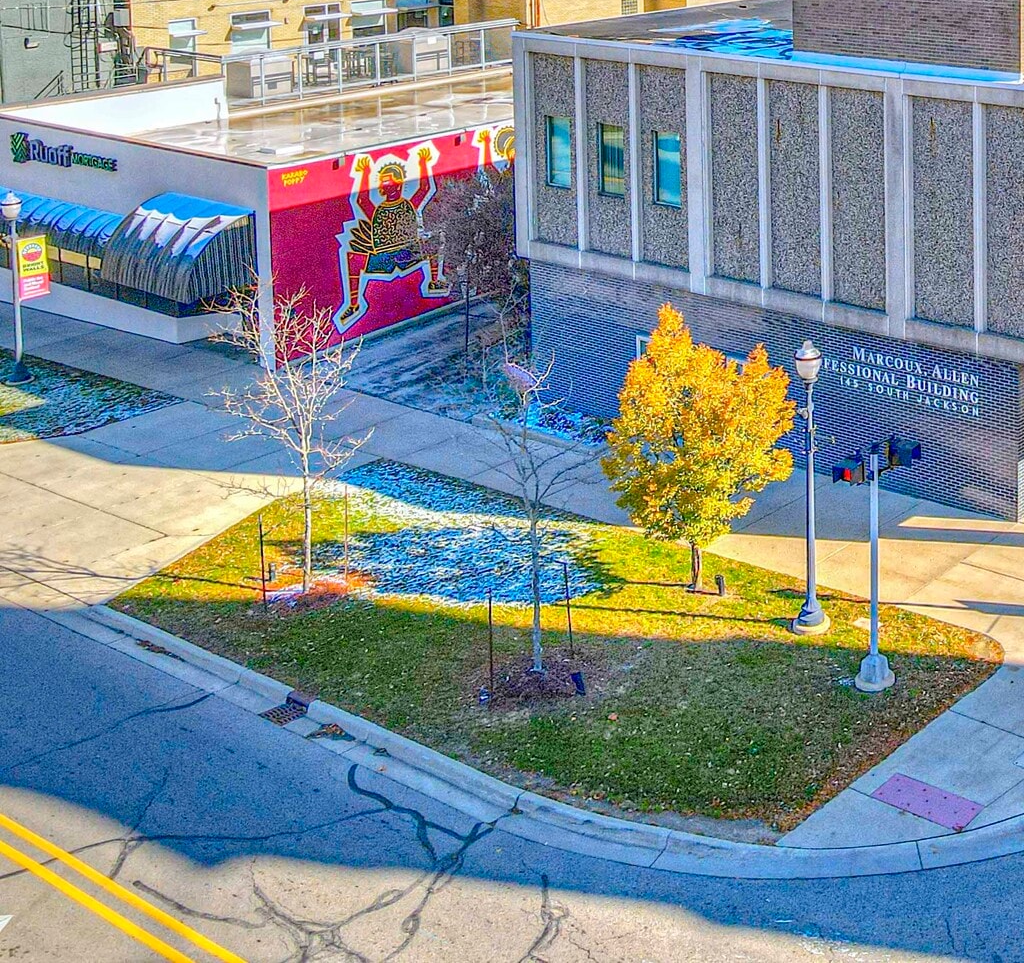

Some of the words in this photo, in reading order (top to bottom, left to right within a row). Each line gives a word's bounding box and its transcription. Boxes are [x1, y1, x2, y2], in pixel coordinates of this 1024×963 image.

[29, 139, 73, 167] Ruoff
[71, 152, 118, 171] MORTGAGE
[823, 357, 899, 386] FESSIONAL
[906, 373, 979, 404] BUILDING
[852, 345, 928, 377] MARCOUX,
[931, 363, 979, 387] ALLEN
[840, 376, 859, 388] 145
[868, 383, 909, 400] SOUTH
[917, 393, 979, 417] JACKSON
